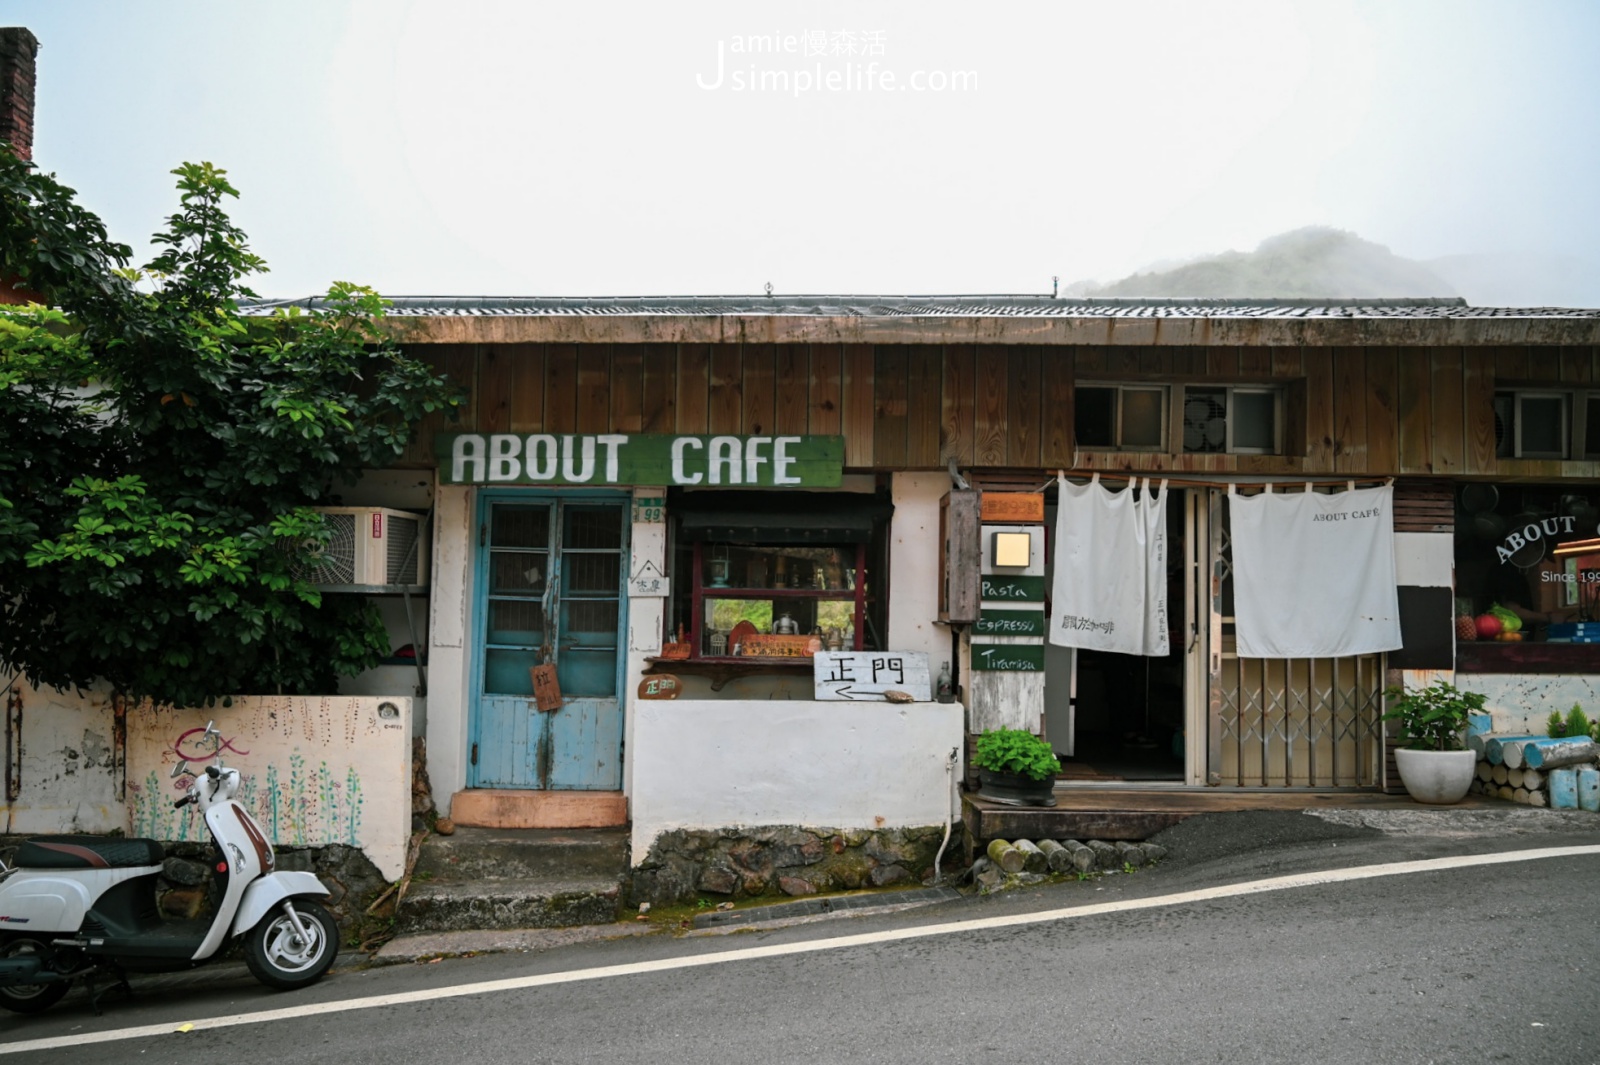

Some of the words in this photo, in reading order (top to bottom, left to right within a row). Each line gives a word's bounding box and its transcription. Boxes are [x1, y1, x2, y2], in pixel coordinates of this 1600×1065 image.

[452, 434, 629, 483] ABOUT
[671, 436, 802, 485] CAFE
[644, 508, 661, 521] 99
[1312, 512, 1349, 522] ABOUT
[1351, 507, 1380, 519] CAFÉ
[1496, 516, 1576, 565] ABOUT
[1541, 571, 1575, 582] Since
[982, 581, 1027, 597] Pasta
[823, 657, 904, 685] 正門
[645, 679, 676, 695] 正門
